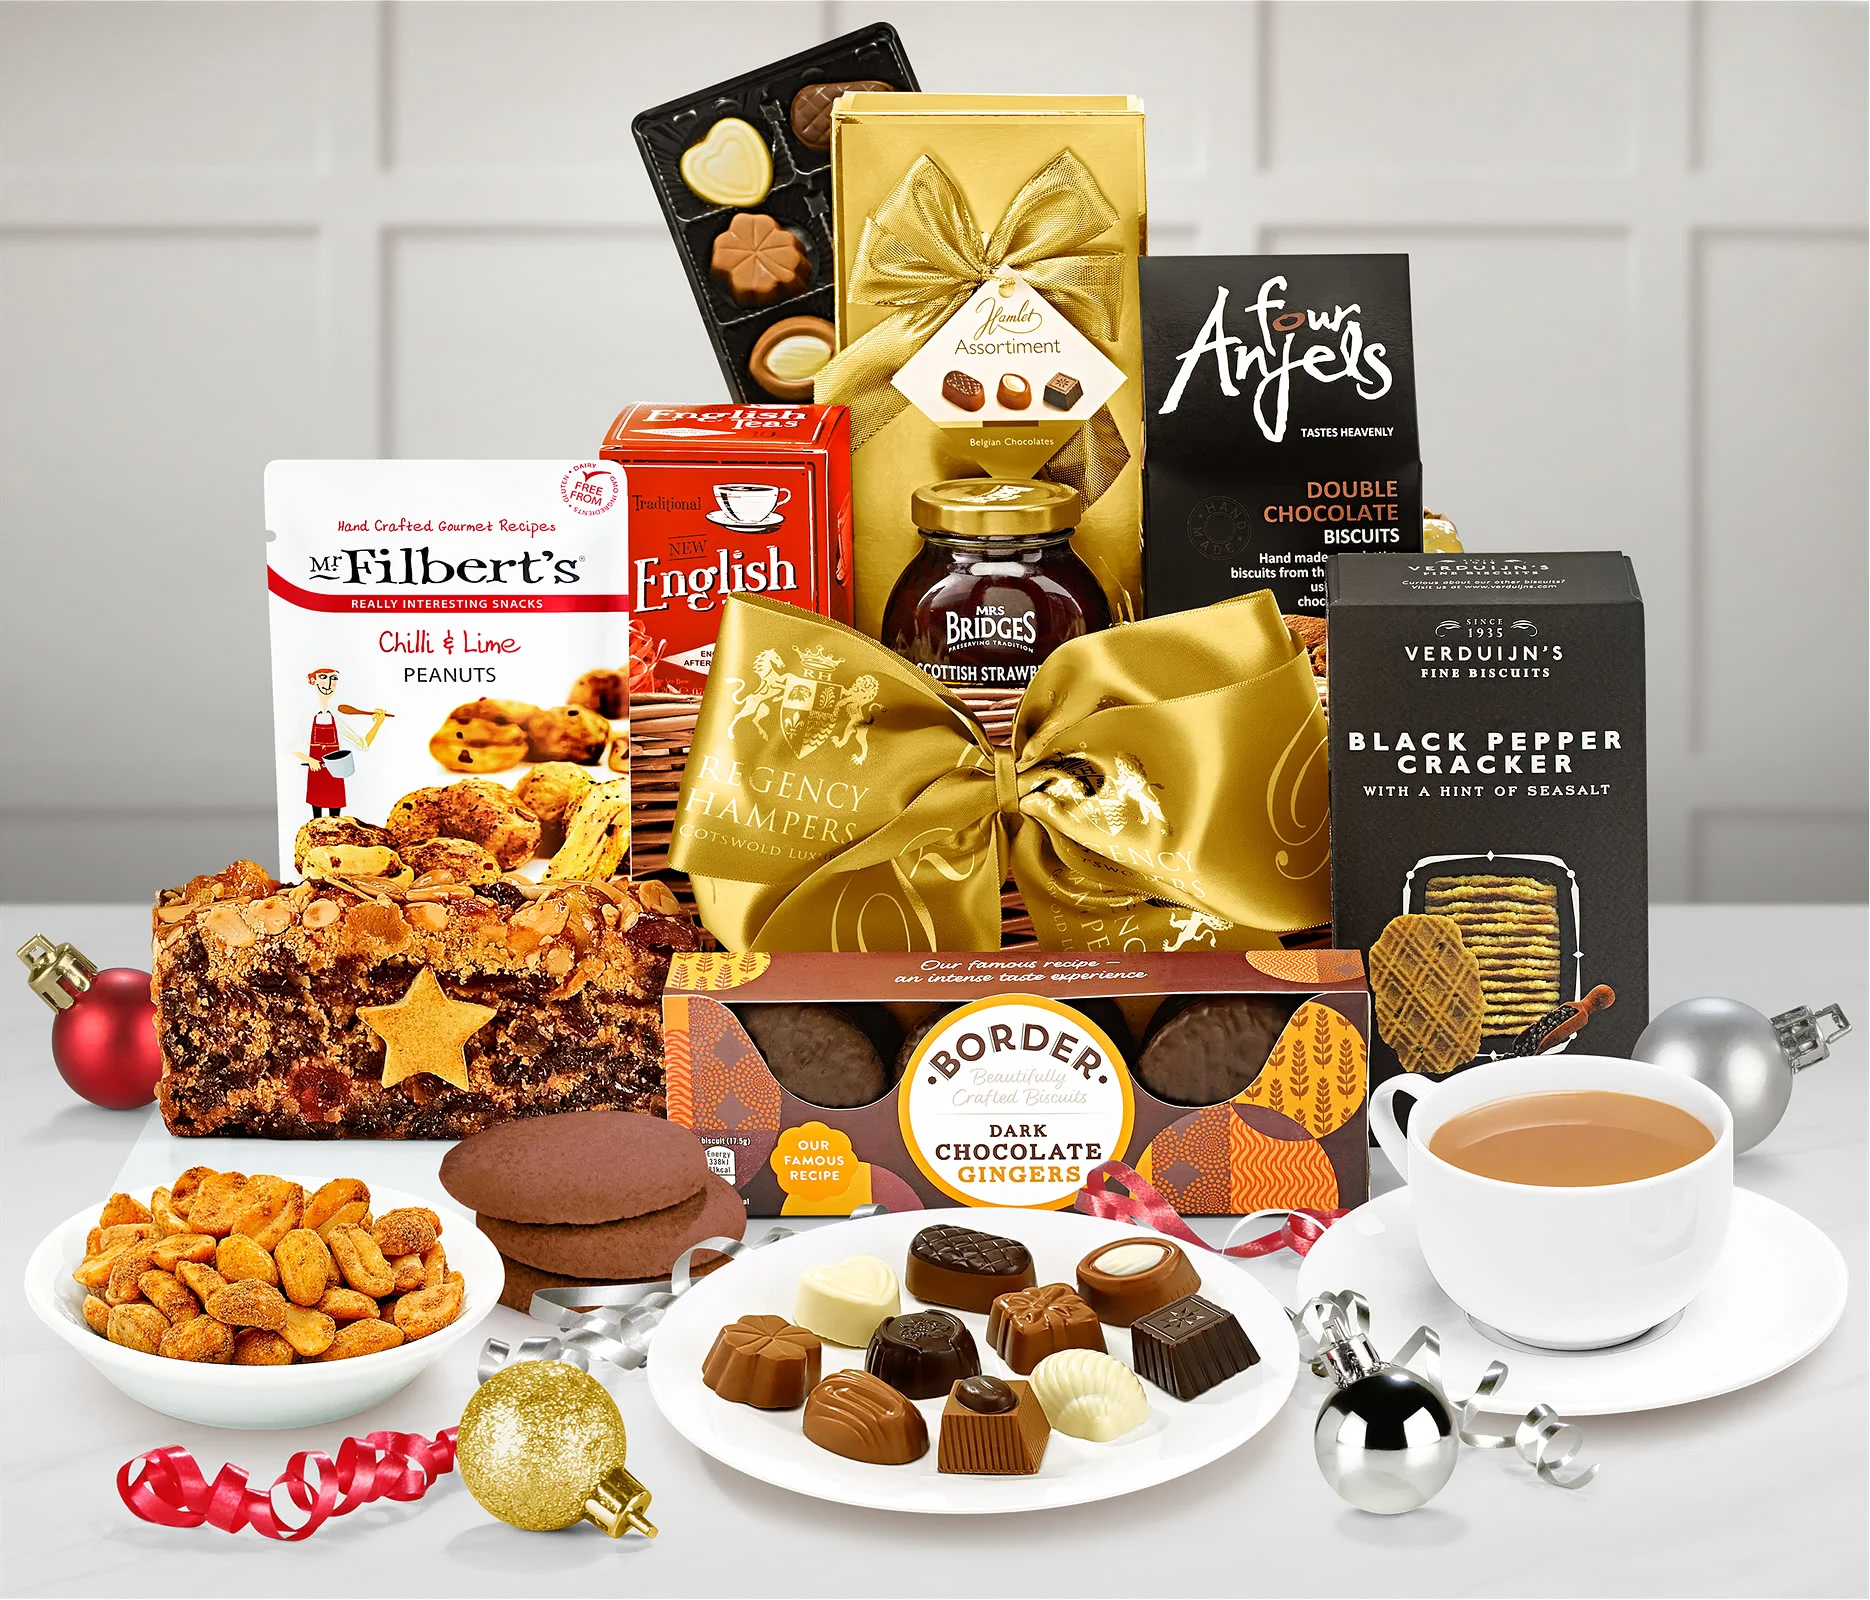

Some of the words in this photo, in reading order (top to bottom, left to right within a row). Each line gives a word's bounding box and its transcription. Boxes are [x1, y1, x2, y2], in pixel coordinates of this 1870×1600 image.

[974, 298, 1042, 340] Hamlet
[1245, 275, 1361, 356] four
[954, 338, 1061, 355] Assortiment
[642, 409, 807, 422] English
[731, 418, 799, 430] Teas
[1301, 427, 1338, 438] TASTES
[1340, 426, 1394, 438] HEAVENLY
[970, 438, 1001, 448] Belgian
[1004, 436, 1054, 446] Chocolates
[573, 462, 597, 472] DAIRY
[560, 475, 570, 503] GLUTEN
[574, 481, 604, 496] FREE
[610, 476, 619, 494] GMO
[1306, 480, 1398, 499] DOUBLE
[570, 490, 602, 506] FROM
[573, 494, 618, 516] INGREDIENTS
[632, 494, 702, 513] Traditional
[1205, 500, 1248, 530] HAND
[1263, 504, 1400, 523] CHOCOLATE
[338, 520, 370, 533] Hand
[375, 518, 434, 533] Crafted
[438, 520, 493, 533] Gourmet
[500, 520, 556, 539] Recipes
[1324, 528, 1400, 545] BISCUITS
[669, 540, 707, 556] NEW
[1192, 526, 1235, 556] MADE
[309, 554, 343, 580] Mr
[341, 546, 581, 586] Filbert's
[1259, 552, 1291, 564] Hand
[1294, 552, 1328, 564] made
[633, 545, 799, 613] English
[1231, 566, 1277, 579] biscuits
[1278, 567, 1310, 578] from
[351, 599, 398, 610] REALLY
[402, 598, 489, 610] INTERESTING
[492, 598, 544, 610] SNACKS
[976, 606, 1005, 616] MRS
[945, 610, 1036, 646] BRIDGES
[1466, 618, 1504, 626] SINCE
[1467, 627, 1504, 638] 1935
[379, 629, 434, 654] Chilli
[443, 630, 456, 656] &
[464, 629, 522, 654] Lime
[948, 639, 990, 653] PRESERVING
[992, 640, 1034, 654] TRADITION
[1404, 645, 1564, 662] VERDUIJN'S
[404, 667, 497, 684] PEANUTS
[803, 669, 832, 682] RH
[916, 663, 978, 682] SCOTTISH
[1421, 668, 1460, 678] FINE
[1468, 668, 1550, 678] BISCUITS
[1348, 732, 1468, 752] BLACK
[1488, 730, 1622, 752] PEPPER
[1397, 754, 1574, 775] CRACKER
[697, 755, 870, 812] REGENCY
[1363, 786, 1409, 797] WITH
[1418, 786, 1432, 797] A
[1440, 786, 1484, 797] HINT
[1494, 786, 1518, 796] OF
[1528, 784, 1612, 796] SEASALT
[684, 788, 857, 845] HAMPERS
[680, 824, 782, 856] COTSWOLD
[920, 959, 963, 971] Our
[968, 959, 1038, 971] famous
[1043, 959, 1100, 970] recipe
[895, 975, 924, 984] an
[928, 972, 994, 984] intense
[1000, 972, 1046, 982] taste
[1051, 970, 1148, 982] experience
[929, 1023, 1102, 1080] BORDER
[970, 1068, 1066, 1089] Beautifully
[952, 1088, 1019, 1106] Crafted
[1023, 1088, 1088, 1106] Biscuits
[989, 1124, 1048, 1138] DARK
[701, 1136, 726, 1145] biscuit
[726, 1136, 752, 1146] (17.5g)
[797, 1140, 830, 1151] OUR
[706, 1150, 731, 1159] Energy
[784, 1154, 845, 1167] FAMOUS
[935, 1143, 1102, 1161] CHOCOLATE
[790, 1170, 840, 1182] RECIPE
[958, 1166, 1081, 1183] GINGERS
